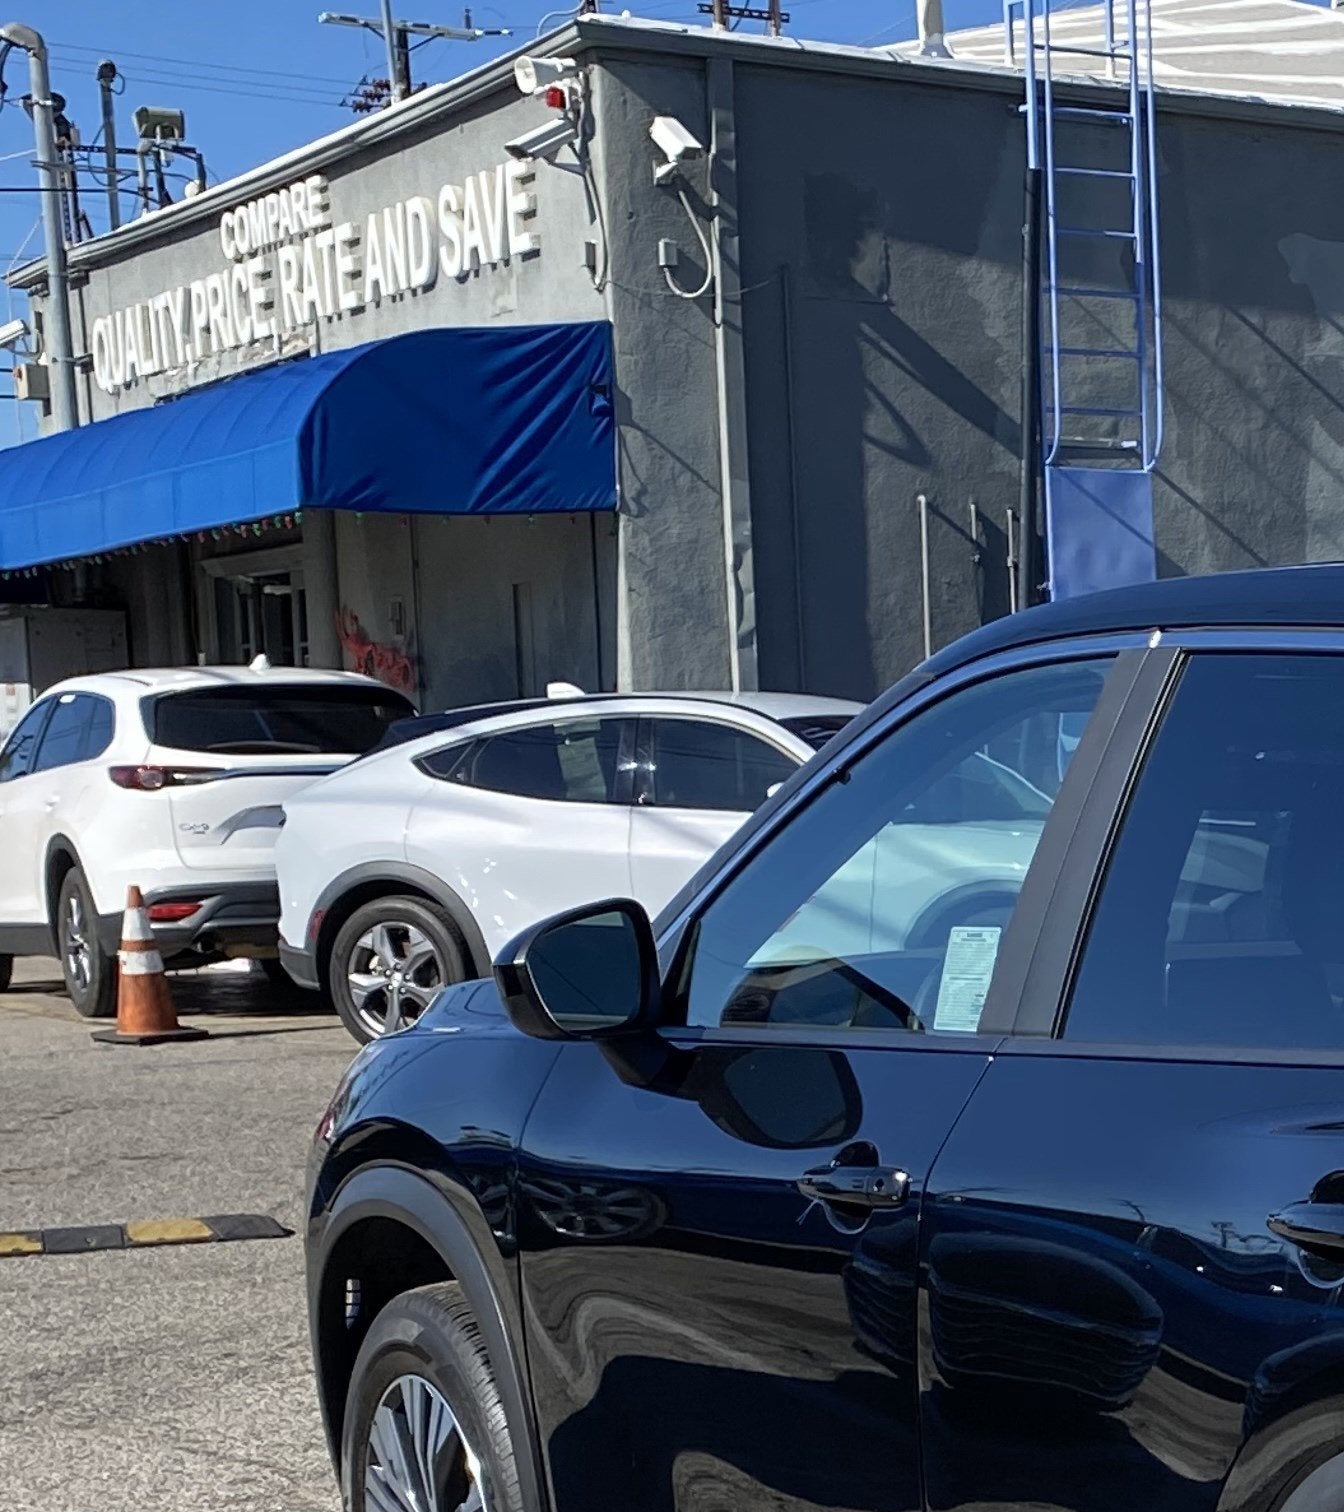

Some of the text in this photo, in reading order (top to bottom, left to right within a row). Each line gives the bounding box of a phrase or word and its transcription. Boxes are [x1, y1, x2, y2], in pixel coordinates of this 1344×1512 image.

[220, 174, 326, 260] COMPARE
[278, 222, 361, 330] RATE
[364, 195, 437, 303] AND
[437, 158, 539, 278] SAVE
